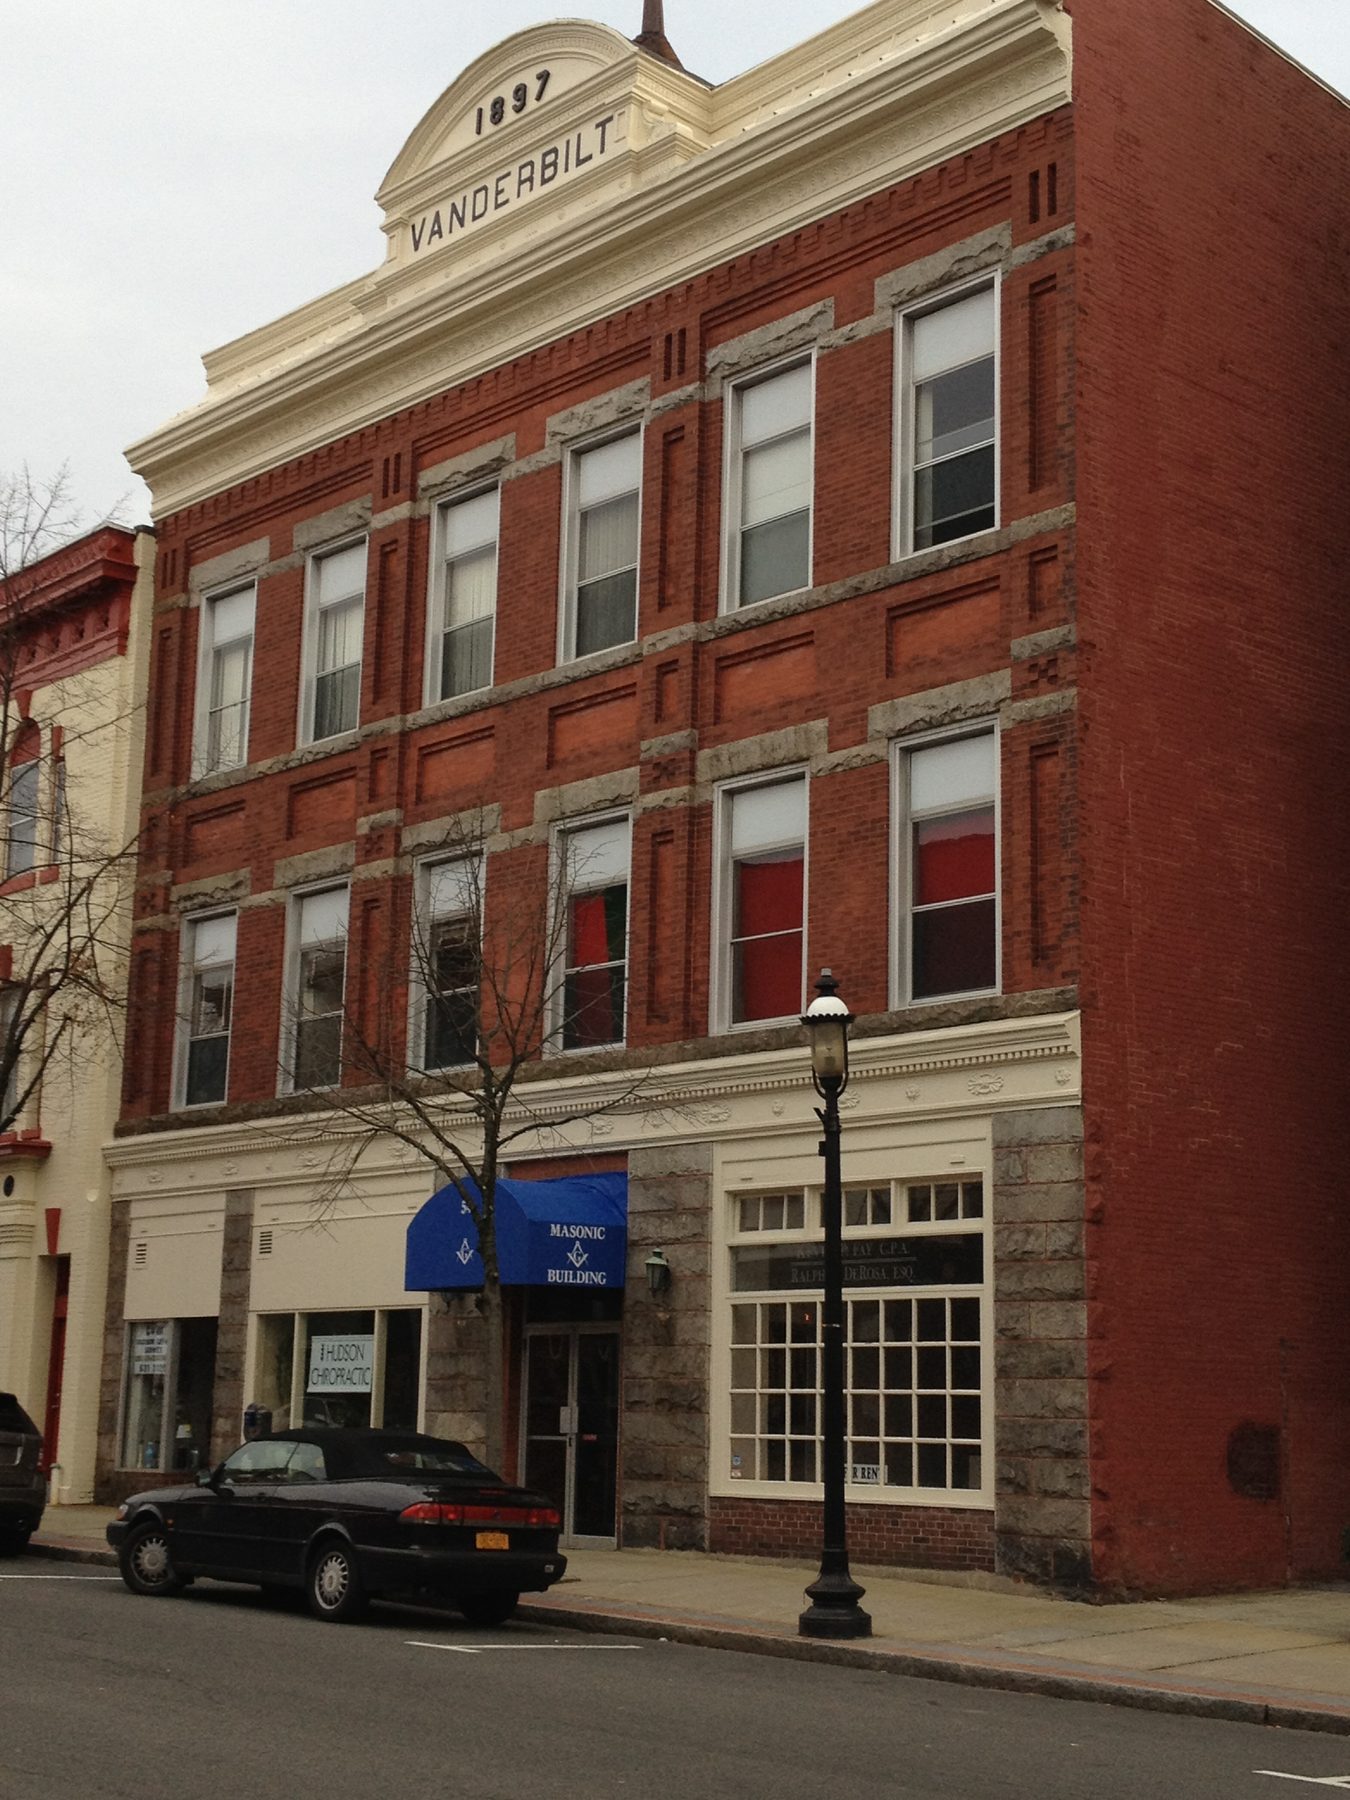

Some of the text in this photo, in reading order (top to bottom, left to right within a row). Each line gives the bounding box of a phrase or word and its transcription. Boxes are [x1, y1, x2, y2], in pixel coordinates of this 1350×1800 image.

[475, 69, 551, 136] 1897
[411, 115, 614, 252] VANDERBILT
[550, 1223, 606, 1240] MASONIC
[547, 1269, 606, 1285] BUILDING
[326, 1343, 365, 1361] HUDSON
[311, 1366, 371, 1386] CHIROPRACTIC
[861, 1466, 880, 1480] REN
